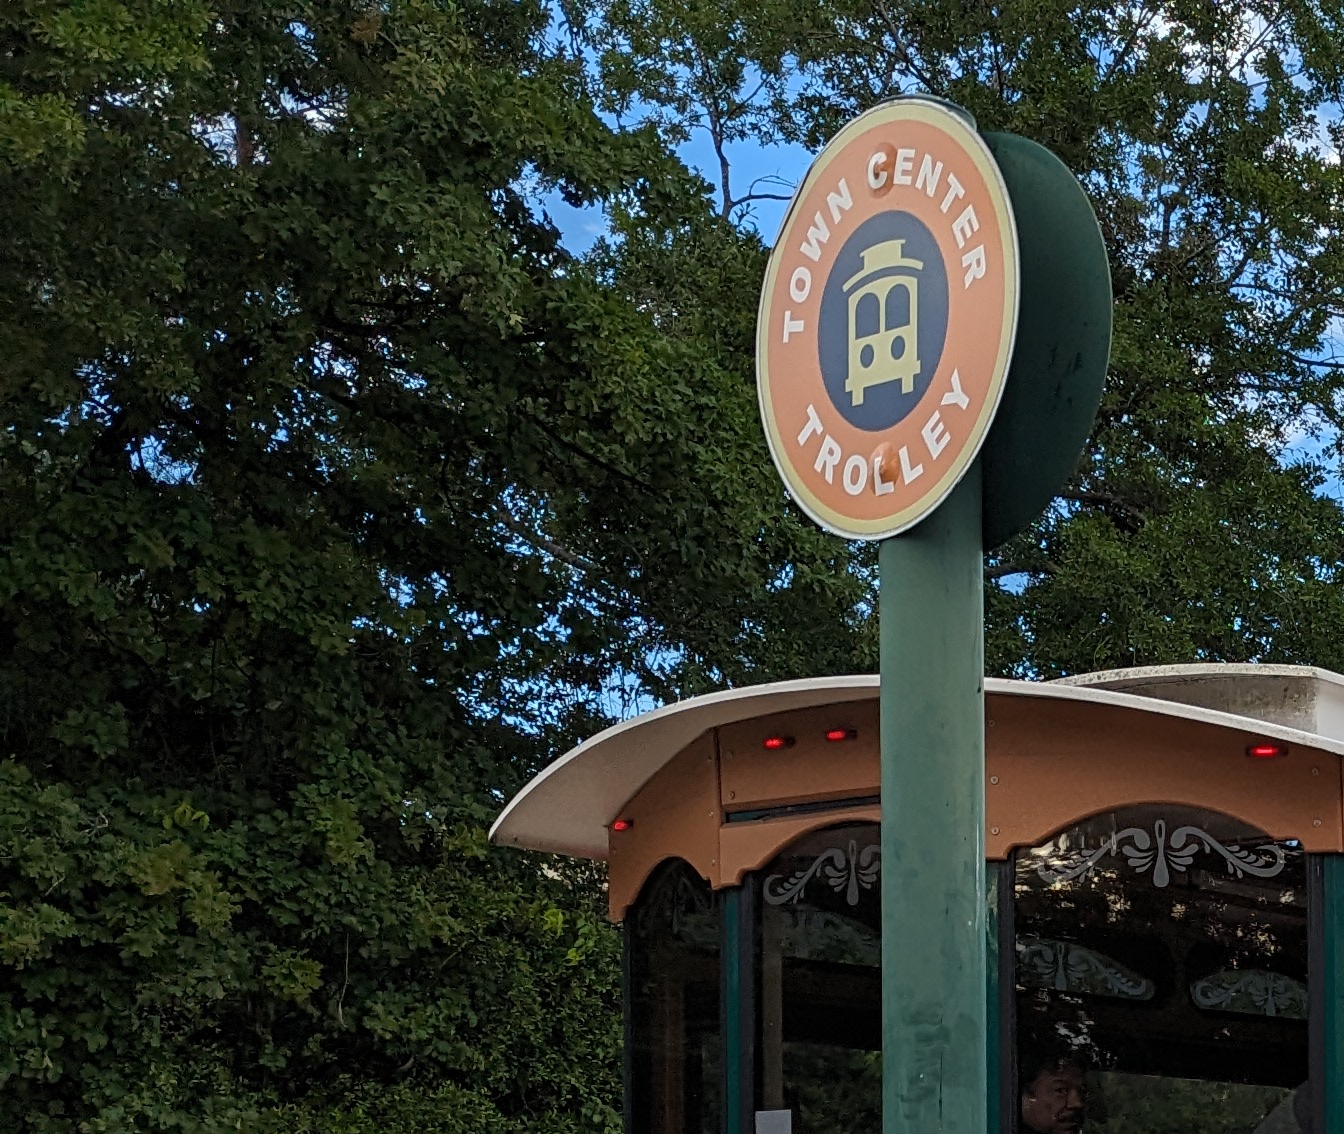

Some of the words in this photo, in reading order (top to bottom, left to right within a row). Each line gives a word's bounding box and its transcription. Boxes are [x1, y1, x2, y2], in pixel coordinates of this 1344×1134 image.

[782, 178, 855, 344] TOWN
[866, 148, 987, 290] CENTER
[797, 368, 971, 497] TROLLEY
